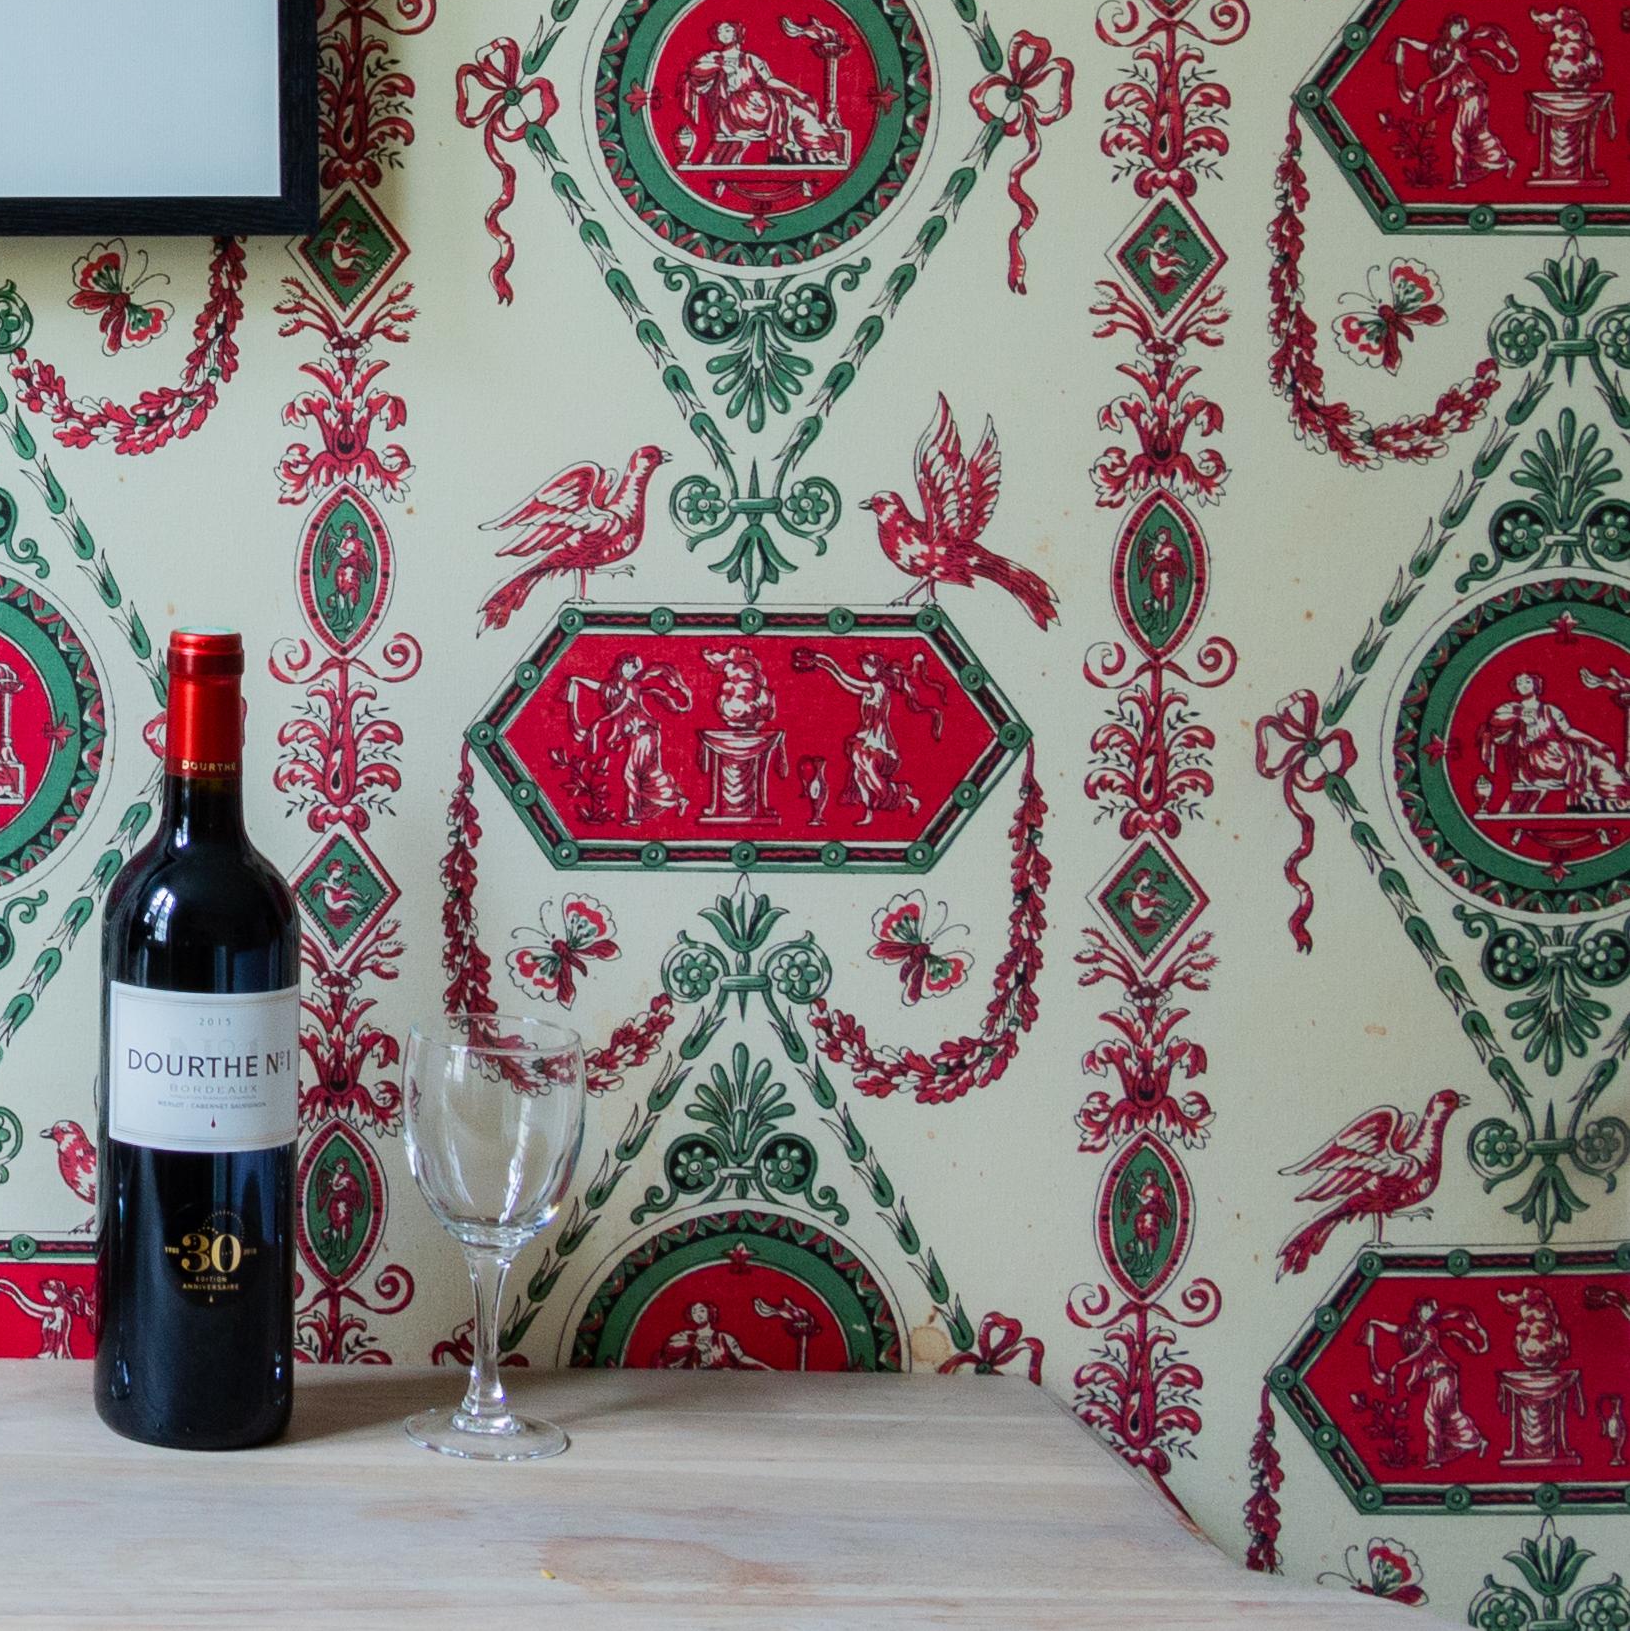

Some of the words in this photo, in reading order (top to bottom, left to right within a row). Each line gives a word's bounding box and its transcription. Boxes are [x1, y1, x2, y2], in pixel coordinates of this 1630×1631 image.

[198, 1017, 232, 1027] 2015
[127, 1047, 259, 1078] DOURTHE
[168, 1083, 259, 1095] BORDEAUX
[190, 1101, 229, 1111] CABERNET
[180, 1232, 242, 1274] 30
[182, 1283, 240, 1291] ANNIVERSAIRE
